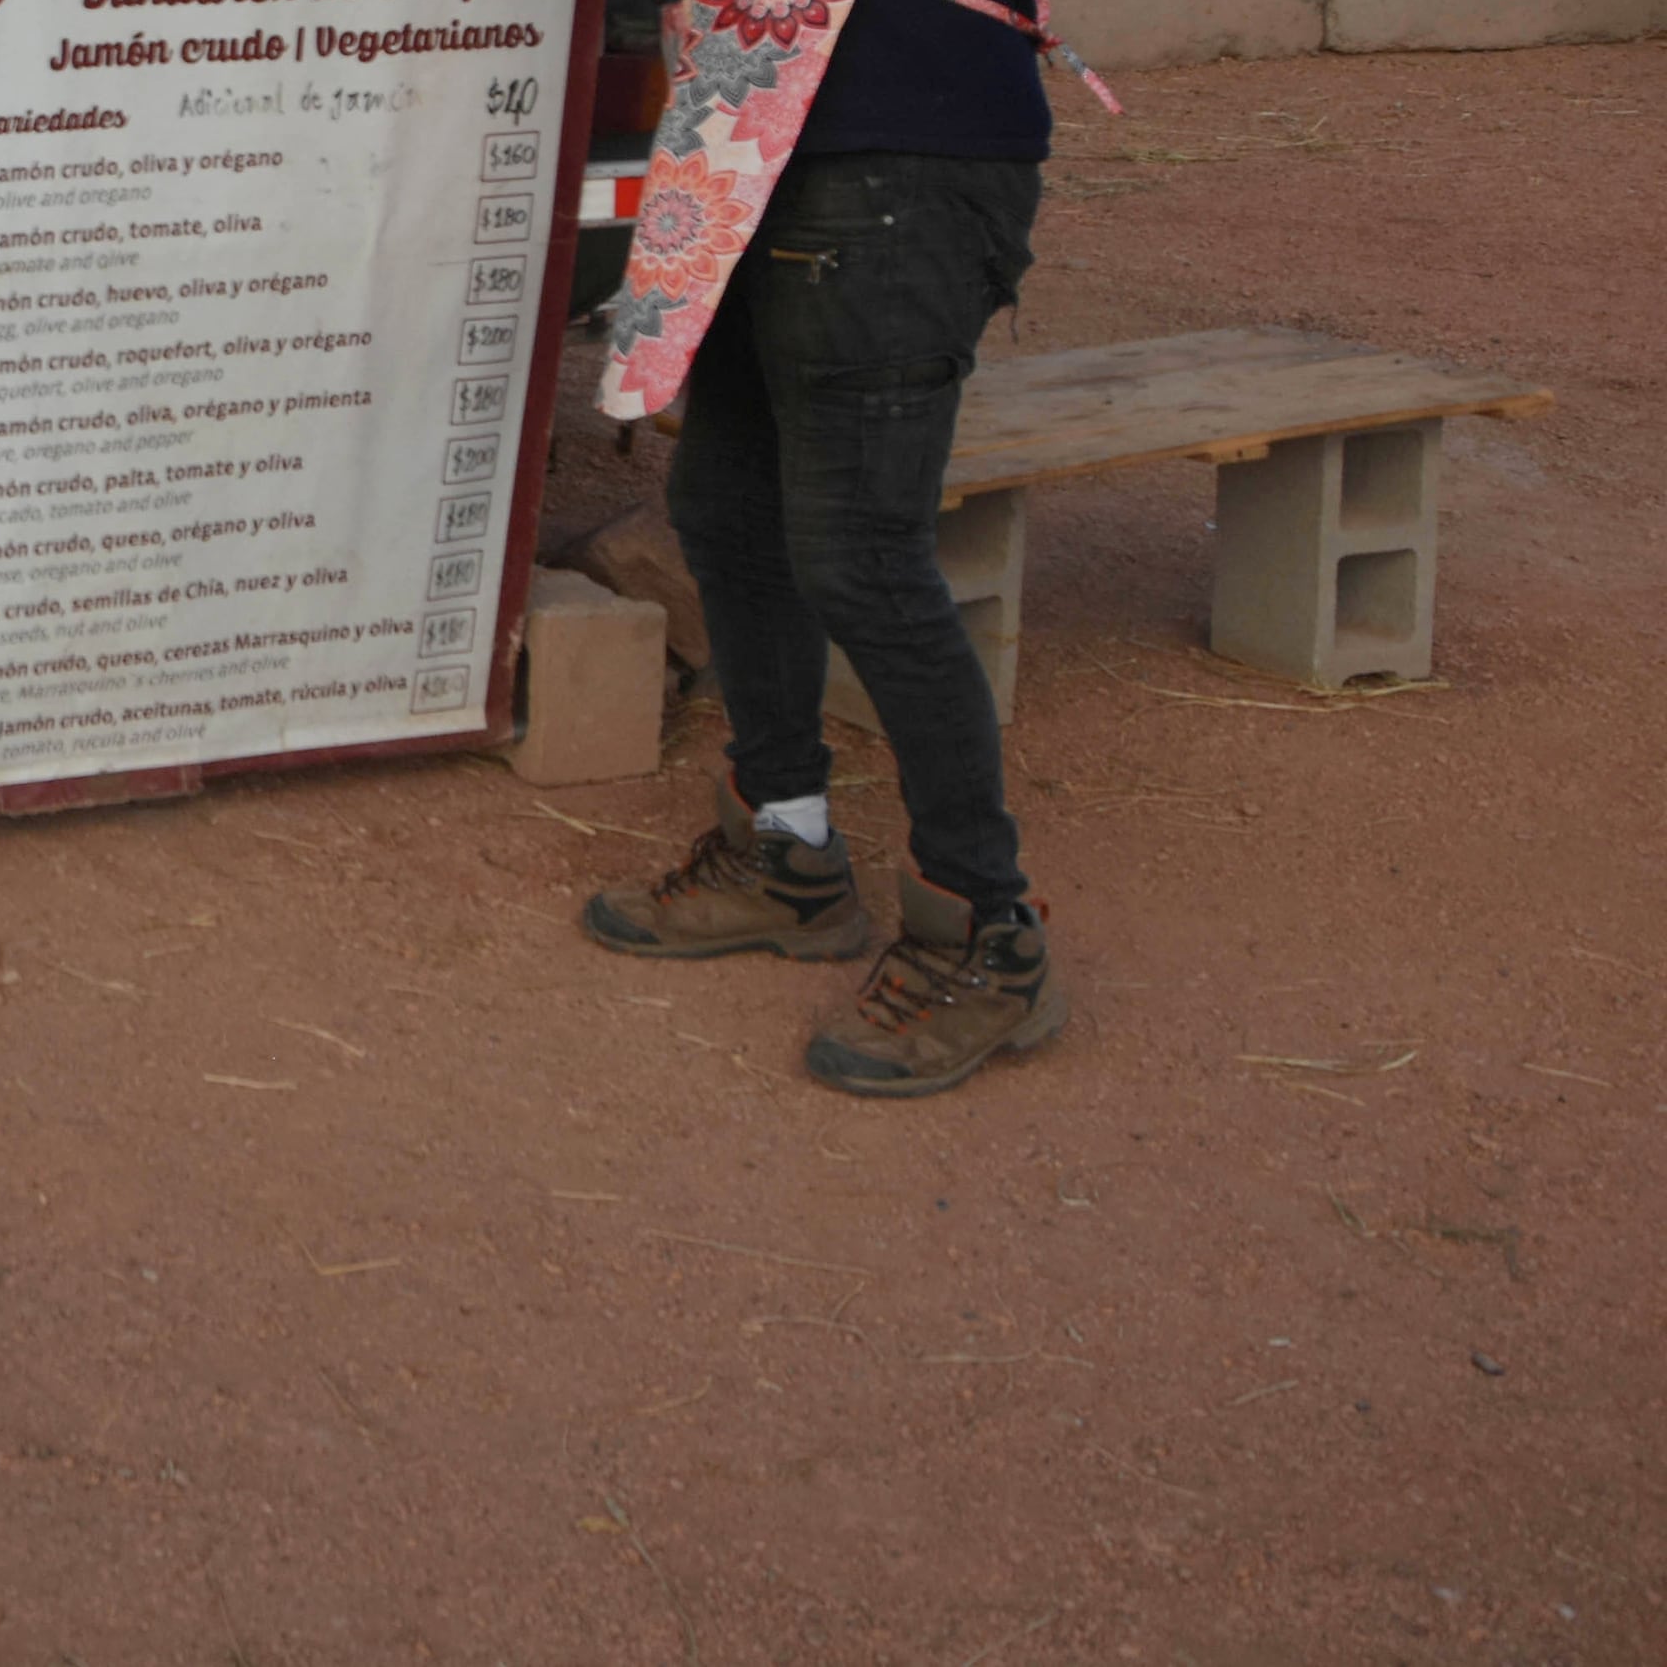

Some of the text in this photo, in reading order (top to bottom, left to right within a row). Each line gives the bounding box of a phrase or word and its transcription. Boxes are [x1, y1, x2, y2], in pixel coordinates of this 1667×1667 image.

[49, 20, 543, 71] Jamón crudo Vegetarianos
[129, 154, 178, 175] oliva
[181, 156, 195, 177] y
[199, 150, 283, 173] orégano
[490, 141, 539, 170] $160
[212, 214, 263, 234] oliva
[481, 207, 528, 230] $180
[178, 278, 227, 298] oliva
[229, 280, 244, 300] y
[248, 273, 328, 295] orégano
[473, 265, 523, 302] $180
[223, 336, 271, 356] oliva
[274, 337, 288, 357] y
[291, 331, 372, 353] orégano
[183, 399, 264, 421] orégano
[267, 398, 281, 417] y
[284, 390, 372, 414] pimienta
[165, 460, 234, 482] tomate
[238, 461, 252, 479] y
[254, 454, 303, 473] oliva
[170, 519, 247, 542] orégano
[250, 517, 265, 537] y
[267, 511, 316, 530] oliva
[72, 589, 152, 612] semillas
[157, 585, 181, 604] de
[284, 574, 298, 593] y
[301, 567, 348, 587] oliva
[234, 625, 350, 650] Marrasquino
[353, 625, 366, 643] y
[368, 618, 414, 637] oliva
[349, 682, 361, 700] y
[364, 675, 408, 694] oliva
